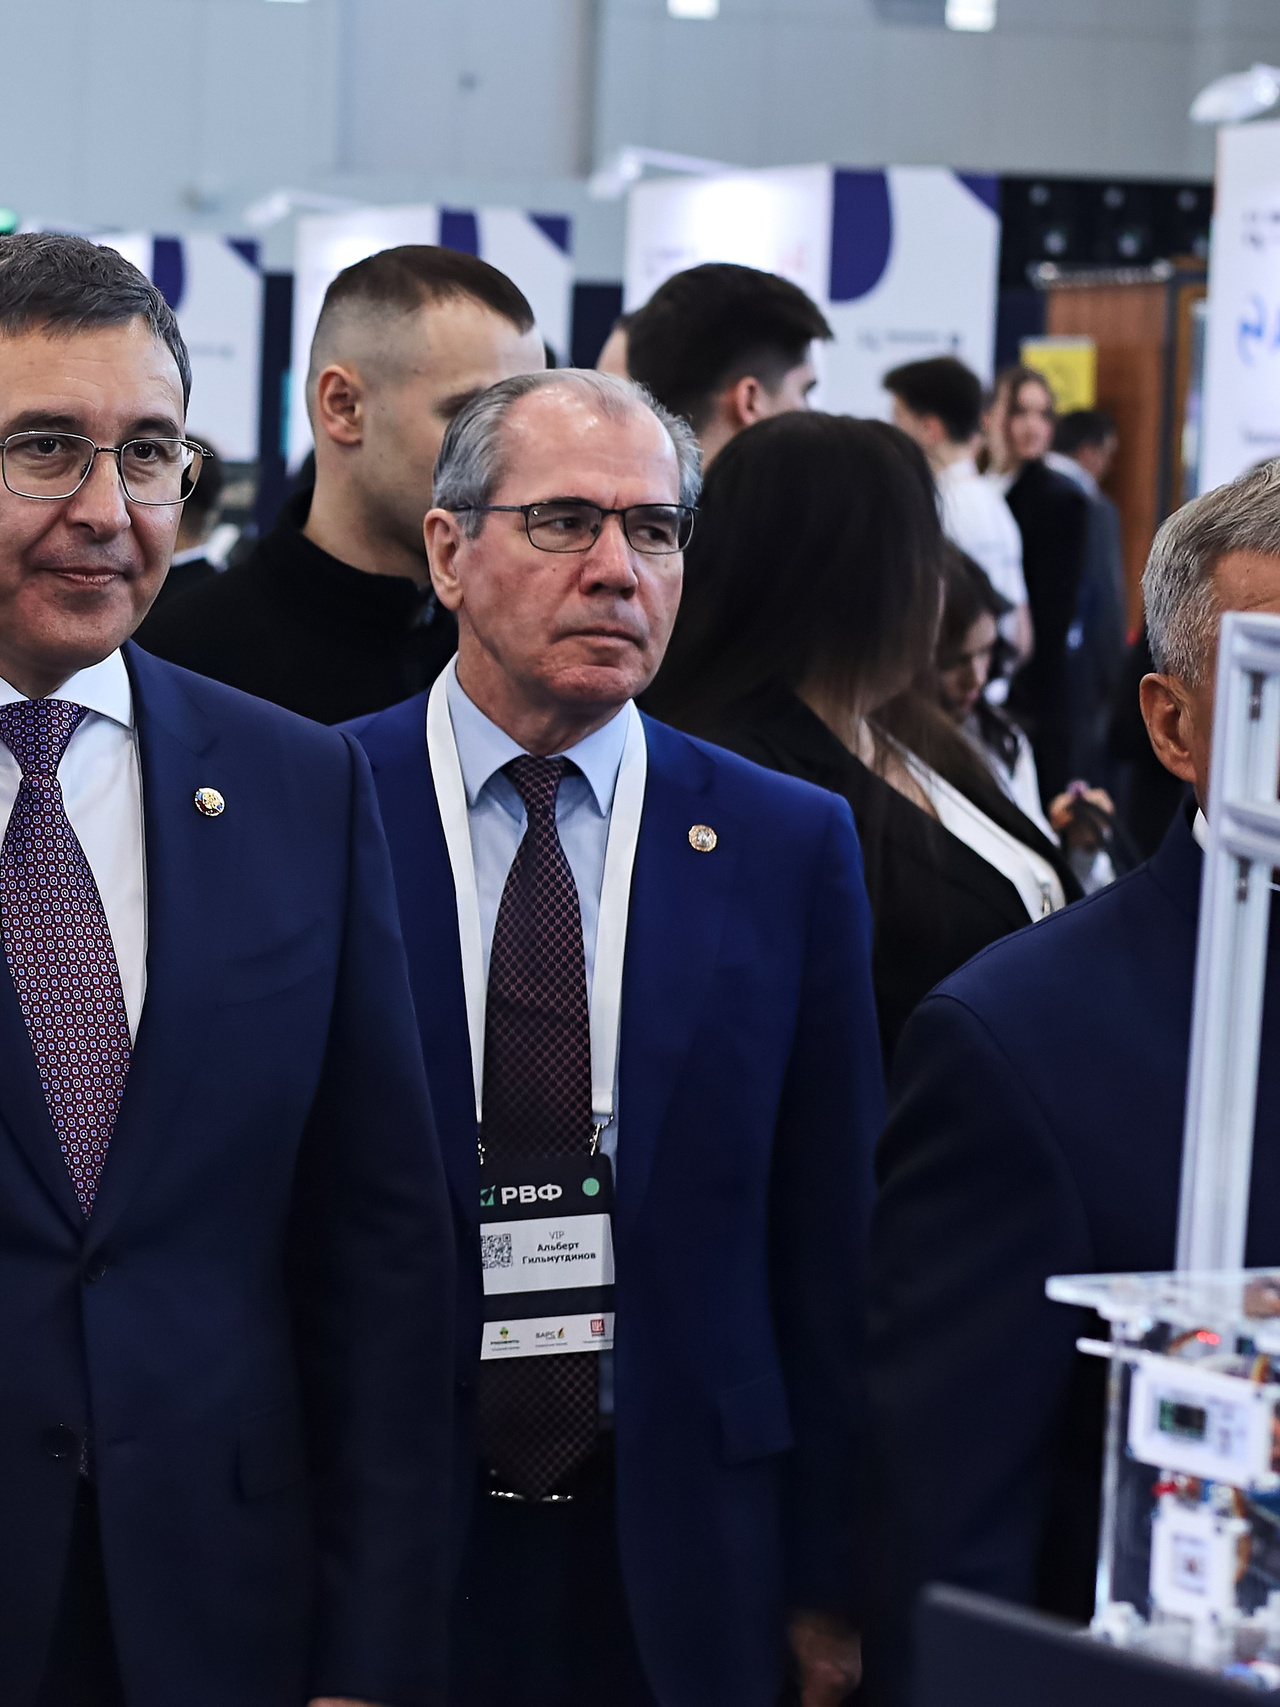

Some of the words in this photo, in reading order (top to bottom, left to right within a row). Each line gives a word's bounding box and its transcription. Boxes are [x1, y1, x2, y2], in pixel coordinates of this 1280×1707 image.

[500, 1183, 563, 1205] РВФ
[549, 1230, 565, 1240] VIP
[537, 1241, 579, 1252] Альберт
[522, 1252, 596, 1265] Гильмутдинов
